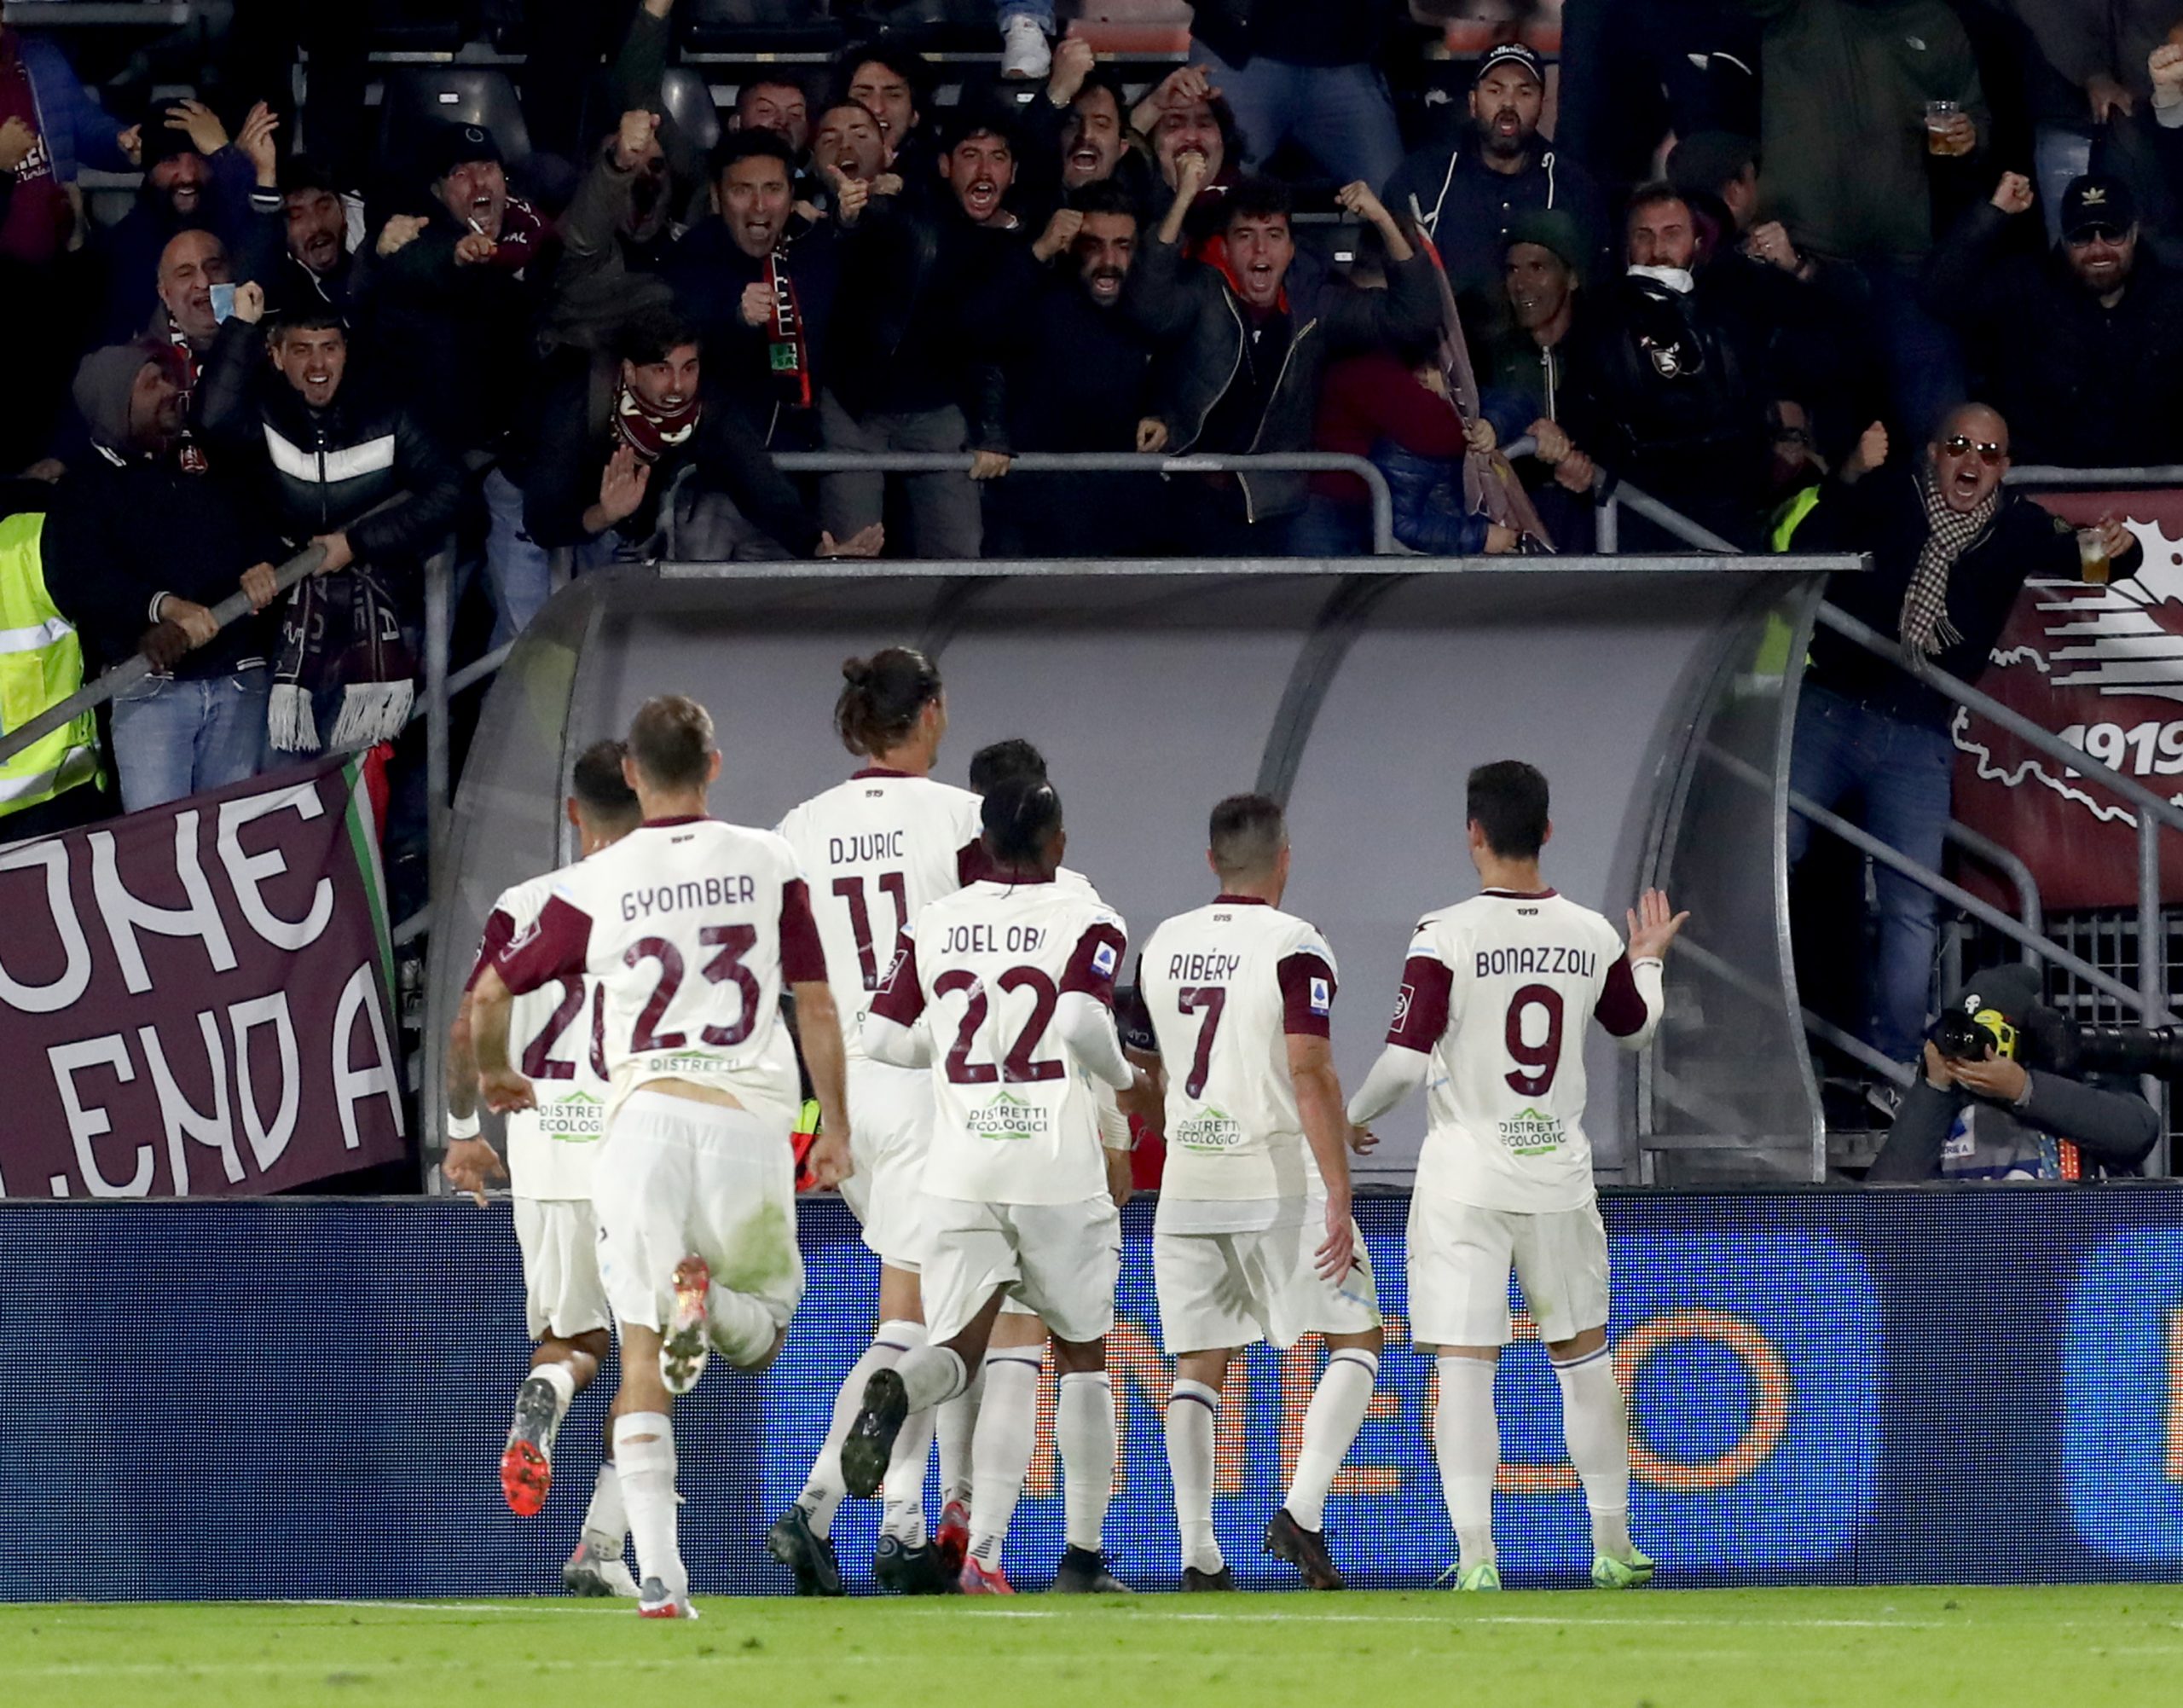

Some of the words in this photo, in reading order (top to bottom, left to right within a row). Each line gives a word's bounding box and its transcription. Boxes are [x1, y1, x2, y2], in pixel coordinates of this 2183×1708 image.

[830, 830, 903, 865] DJURIC
[622, 875, 755, 922] GYOMBER
[941, 924, 999, 954] JOEL
[1006, 926, 1047, 952] OBI
[1168, 947, 1241, 981] RIBÉRY
[1476, 947, 1595, 979] BONAZZOLI
[622, 923, 760, 1055] 23
[933, 965, 1066, 1085] 22
[1504, 983, 1564, 1097] 9
[1178, 987, 1226, 1100] 7
[539, 1105, 604, 1118] DISTRET
[539, 1120, 604, 1132] ECOLOG
[966, 1119, 1047, 1132] ECOLOGICI
[970, 1106, 1047, 1120] DISTRETTI
[1498, 1119, 1562, 1133] DISTRETT
[1500, 1132, 1567, 1147] ECOLOGIC
